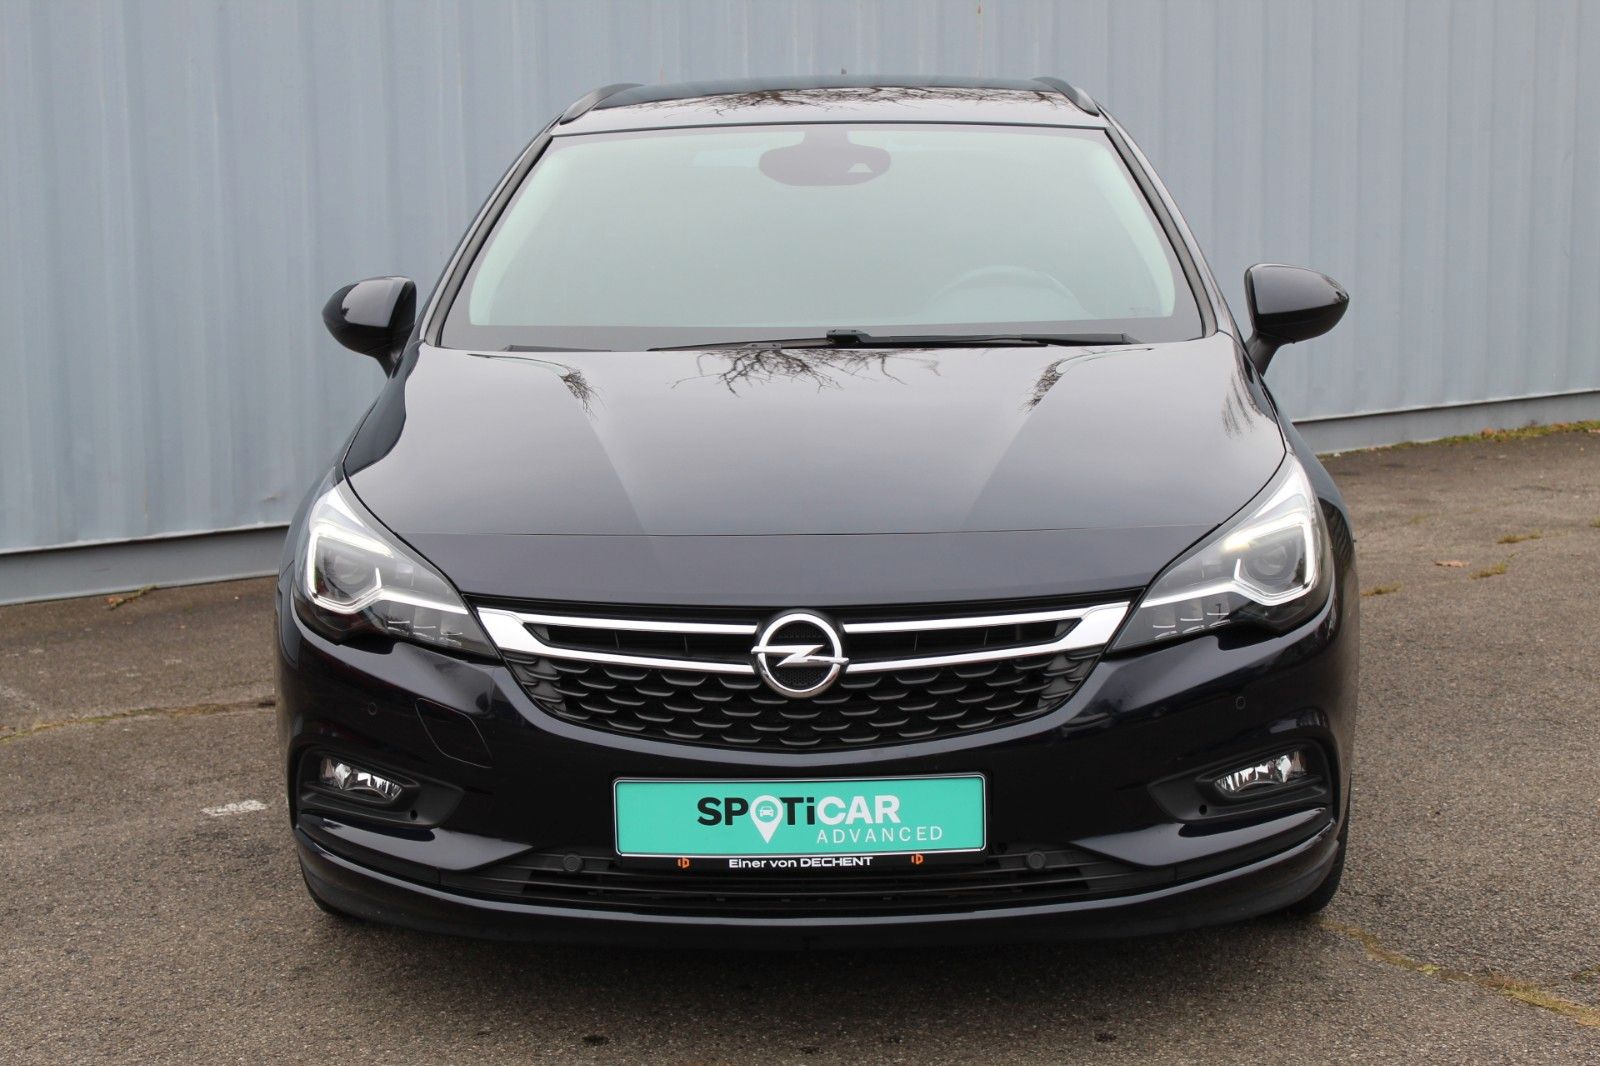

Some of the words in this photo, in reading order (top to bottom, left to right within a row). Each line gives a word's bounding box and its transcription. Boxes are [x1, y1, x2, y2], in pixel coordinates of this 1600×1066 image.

[816, 826, 943, 844] ADVANCED
[728, 858, 767, 868] Einer
[769, 859, 797, 868] von
[800, 856, 873, 868] DECHENT
